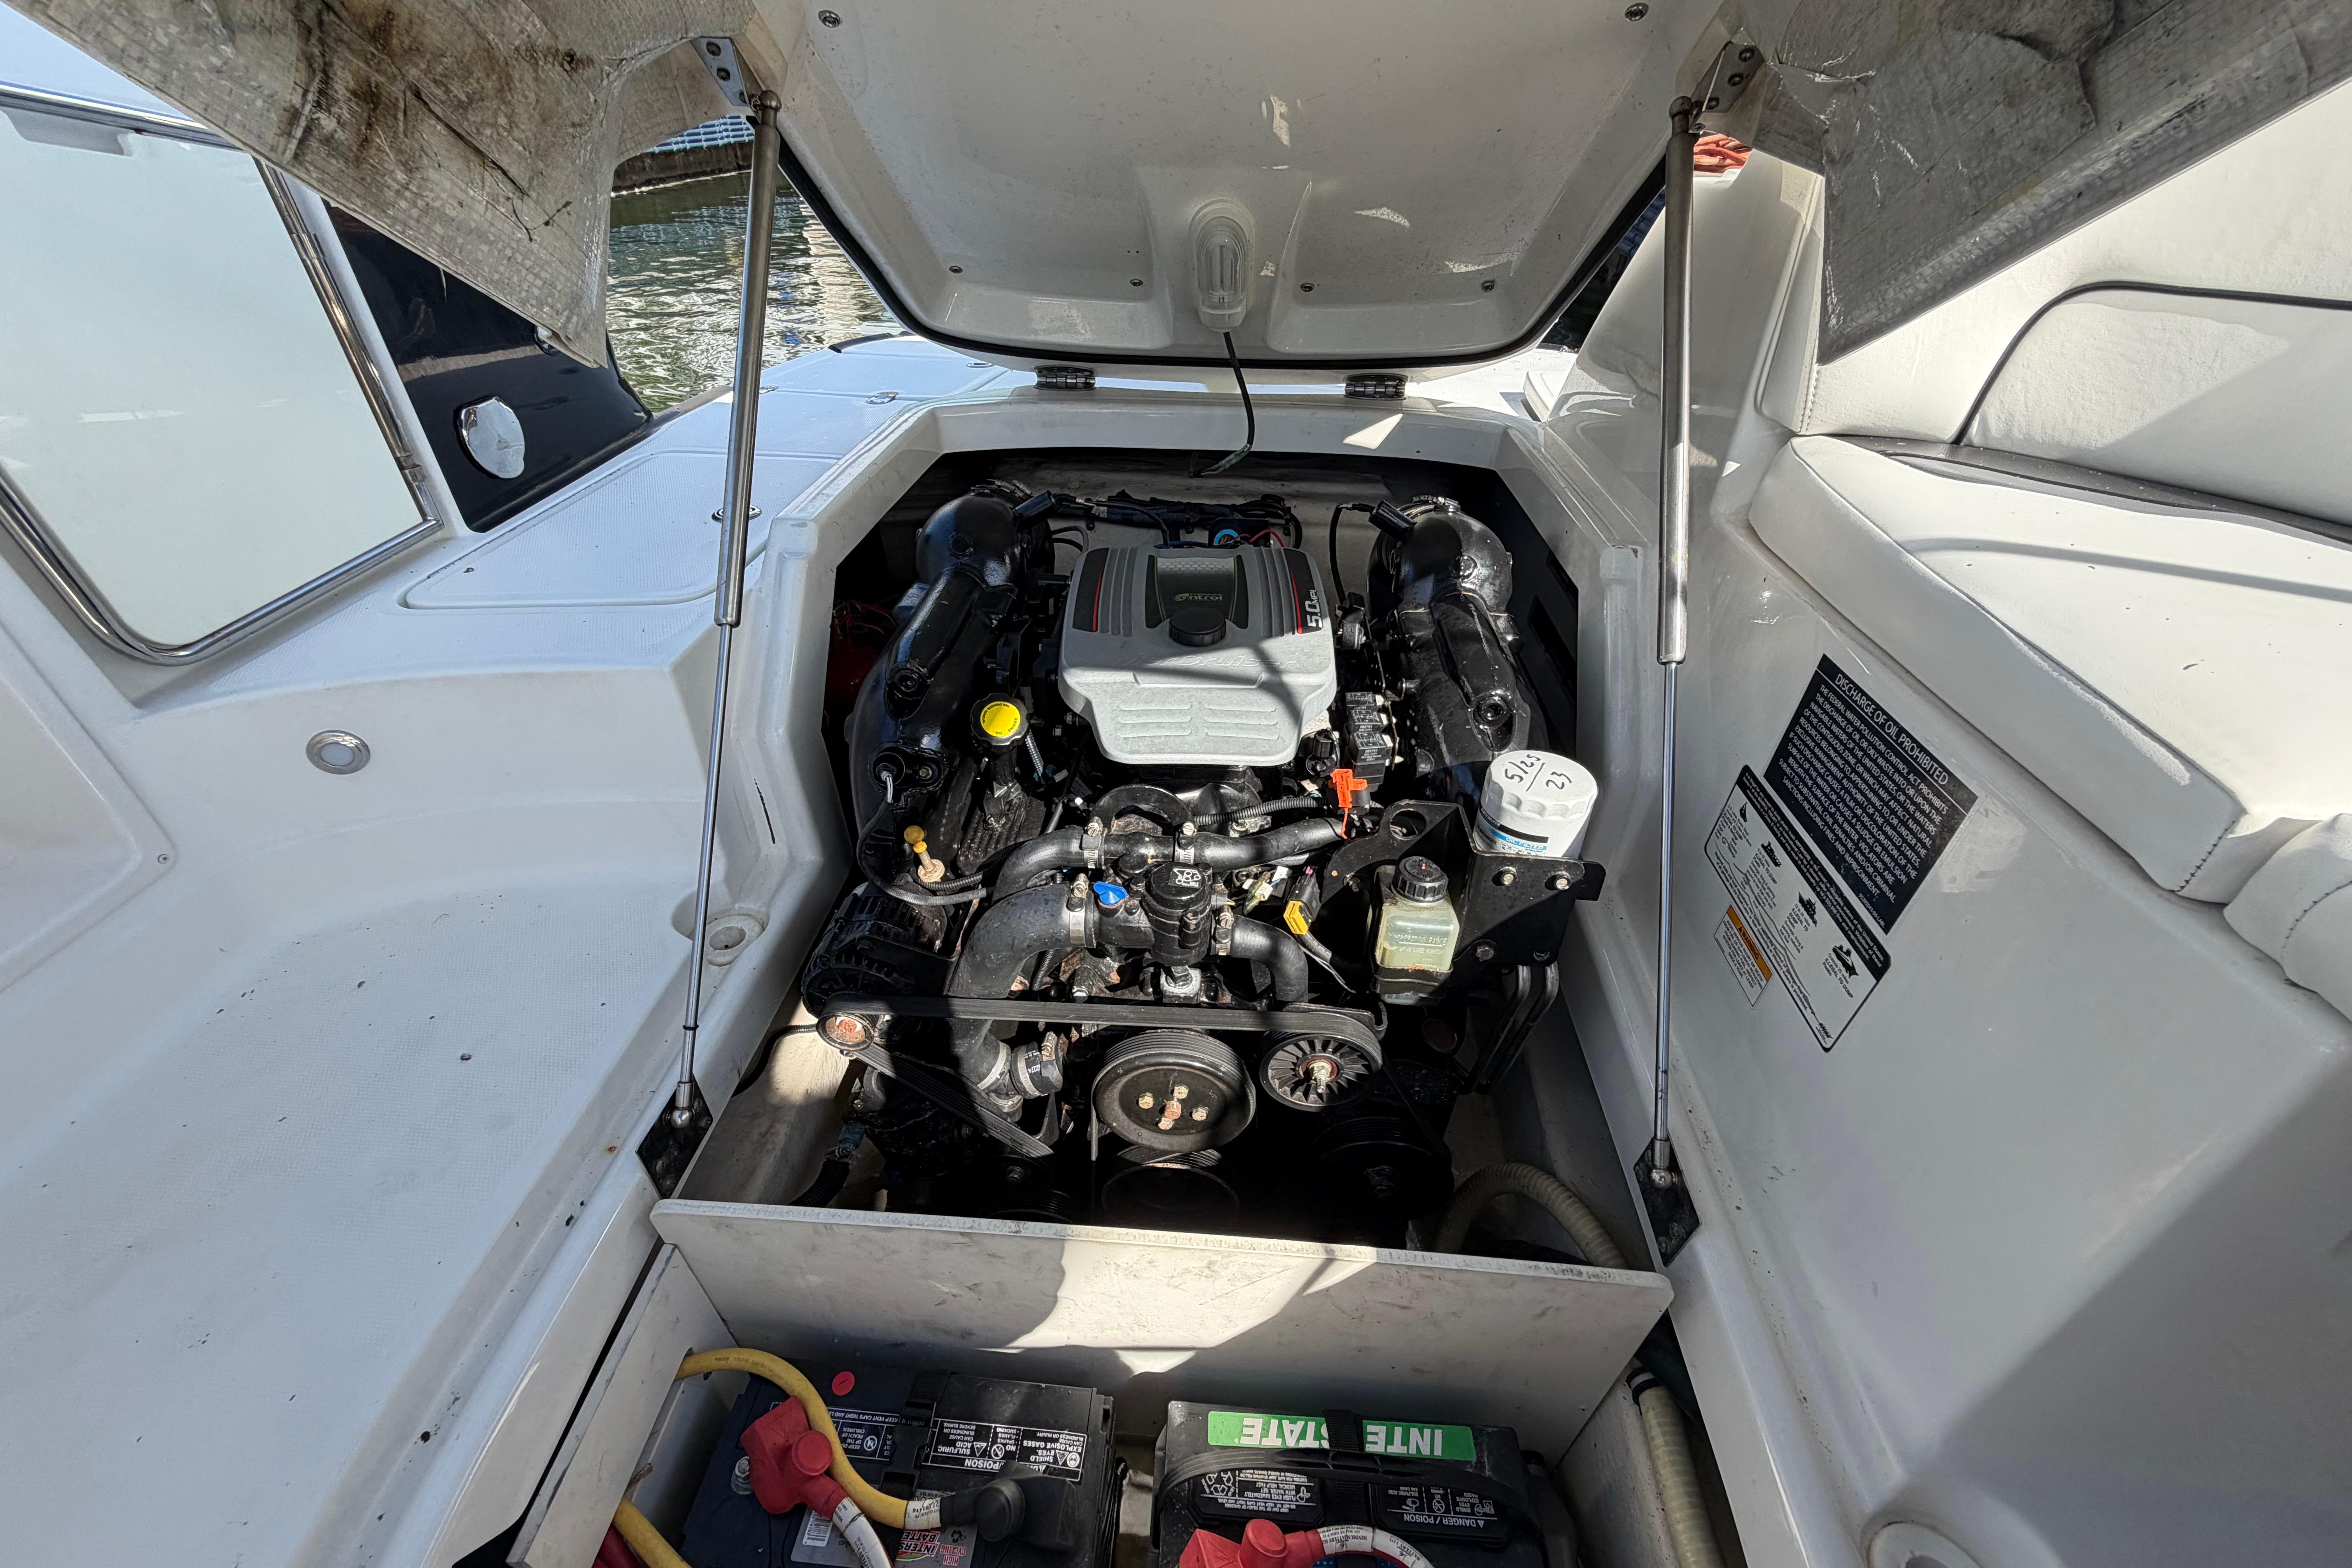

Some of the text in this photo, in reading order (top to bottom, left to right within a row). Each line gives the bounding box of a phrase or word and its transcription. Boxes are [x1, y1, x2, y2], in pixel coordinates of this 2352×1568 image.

[1008, 718, 1018, 732] ENGINE
[1835, 674, 1948, 784] DISCHARGE OF OIL PROHIBITED
[1810, 701, 1832, 727] NAVIGABLE
[1831, 723, 1848, 743] WATERS
[1846, 740, 1855, 749] OF
[1853, 746, 1863, 759] THE
[1862, 756, 1880, 776] UNITED
[1896, 791, 1905, 803] OR
[1904, 799, 1916, 814] THE
[1914, 810, 1937, 835] WATERS
[1815, 693, 1942, 824] THE DISCHARGE OF OIL OR OILY WASTE INTO OR UPON THE
[1820, 684, 1948, 814] THE FEDERAL WATER POLLUTION CONTROL ACT PROHIBITS
[1795, 725, 1815, 749] EXCLUSIVE
[1814, 746, 1843, 779] MANAGEMENT
[1841, 778, 1868, 807] AUTHORITY
[1866, 805, 1875, 814] OF
[1873, 811, 1884, 826] THE
[1883, 823, 1902, 845] UNITED
[1799, 716, 1822, 742] RESOURCES
[1820, 740, 1844, 768] BELONGING
[1850, 773, 1883, 809] APPERTAINING
[1889, 815, 1898, 826] OR
[1897, 823, 1916, 846] UNDER
[1915, 842, 1927, 858] THE
[1804, 708, 1811, 716] OF
[1809, 714, 1818, 726] THE
[1817, 722, 1844, 753] CONTIGUOUS
[1855, 763, 1864, 774] OR
[1862, 770, 1879, 791] WHICH
[1878, 787, 1891, 801] MAY
[1888, 800, 1909, 821] AFFECT
[1907, 819, 1932, 848] NATURAL
[1783, 776, 1804, 803] SANCTIONS
[1802, 800, 1824, 828] INCLUDING
[1822, 826, 1836, 842] FINES
[1834, 841, 1845, 854] AND
[1787, 743, 1804, 764] SURFACE
[1803, 761, 1810, 769] OF
[1808, 766, 1817, 779] THE
[1816, 775, 1830, 794] WATER
[1829, 791, 1837, 801] OR
[1835, 798, 1853, 819] CAUSES
[1855, 821, 1874, 845] SLUDGE
[1873, 842, 1882, 854] OR
[1880, 851, 1907, 883] EMULSION
[1788, 756, 1806, 778] BENEATH
[1804, 775, 1813, 787] THE
[1811, 784, 1830, 807] SURFACE
[1828, 805, 1836, 813] OF
[1834, 811, 1844, 824] THE
[1859, 840, 1884, 872] VIOLATORS
[1883, 870, 1895, 884] ARE
[1792, 736, 1804, 750] SUCH
[1803, 747, 1825, 775] DISCHARGE
[1824, 772, 1841, 792] CAUSES
[1843, 793, 1855, 808] FILM
[1854, 805, 1862, 816] OR
[1860, 813, 1899, 858] DISCOLORATION
[1897, 856, 1907, 865] OF
[1905, 863, 1917, 879] THE
[1519, 841, 1544, 850] FILTER
[1778, 758, 1795, 778] SUBJECT
[1793, 775, 1799, 784] TO
[1798, 782, 1823, 814] SUBSTANTIAL
[1822, 812, 1833, 826] CIVIL
[1832, 824, 1855, 852] PENALTIES
[1853, 850, 1874, 874] AND/OR
[1872, 872, 1895, 903] CRIMINAL
[1741, 929, 1760, 961] WARNING
[1822, 961, 1832, 977] Plastic
[1824, 957, 1853, 1000] ILLEGAL TO DUMP
[938, 1446, 970, 1454] SULFURIC
[1045, 1442, 1081, 1452] EXPLOSIVE
[903, 1532, 937, 1542] BATTE
[1404, 1513, 1434, 1524] POISON
[1443, 1517, 1476, 1527] DANGER
[898, 1542, 936, 1554] INTERS
[941, 1545, 966, 1556] CYCLING
[944, 1555, 959, 1566] HIGH
